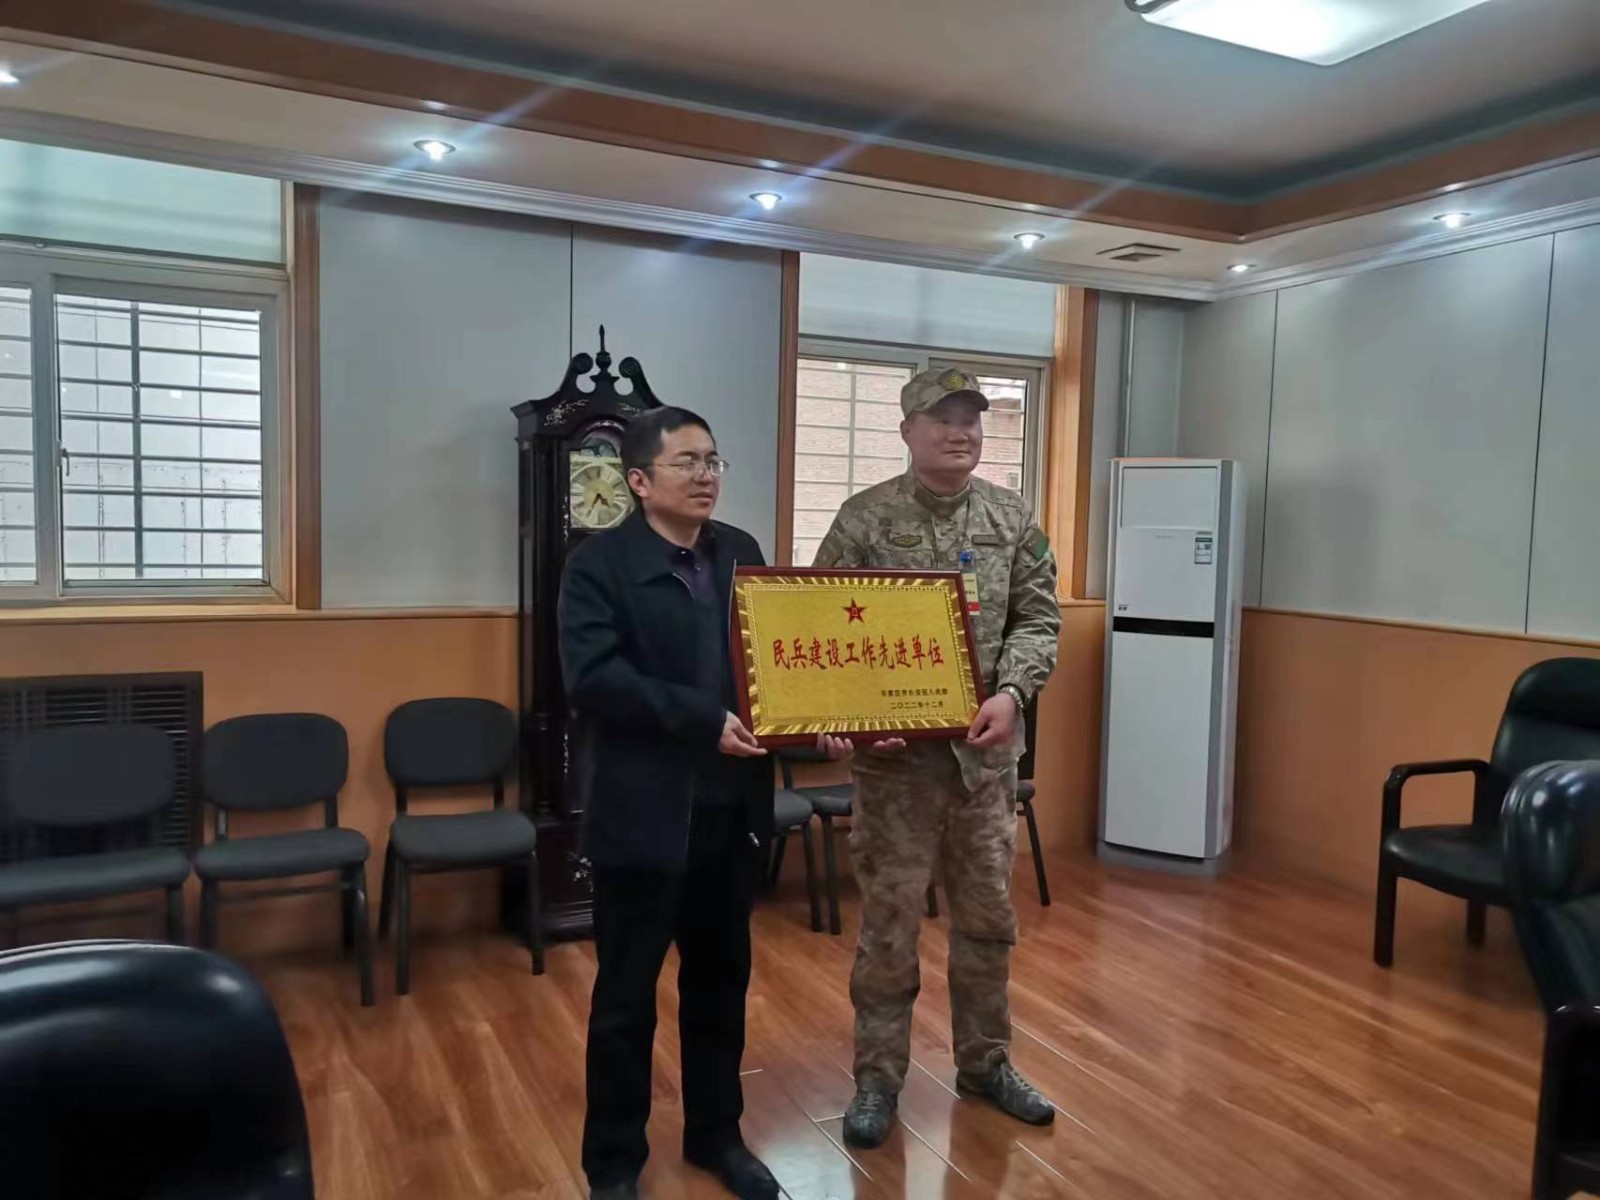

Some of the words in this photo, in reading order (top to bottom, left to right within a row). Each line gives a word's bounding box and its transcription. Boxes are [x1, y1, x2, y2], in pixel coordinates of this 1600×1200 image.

[772, 633, 944, 671] 民兵建设工作先进单位
